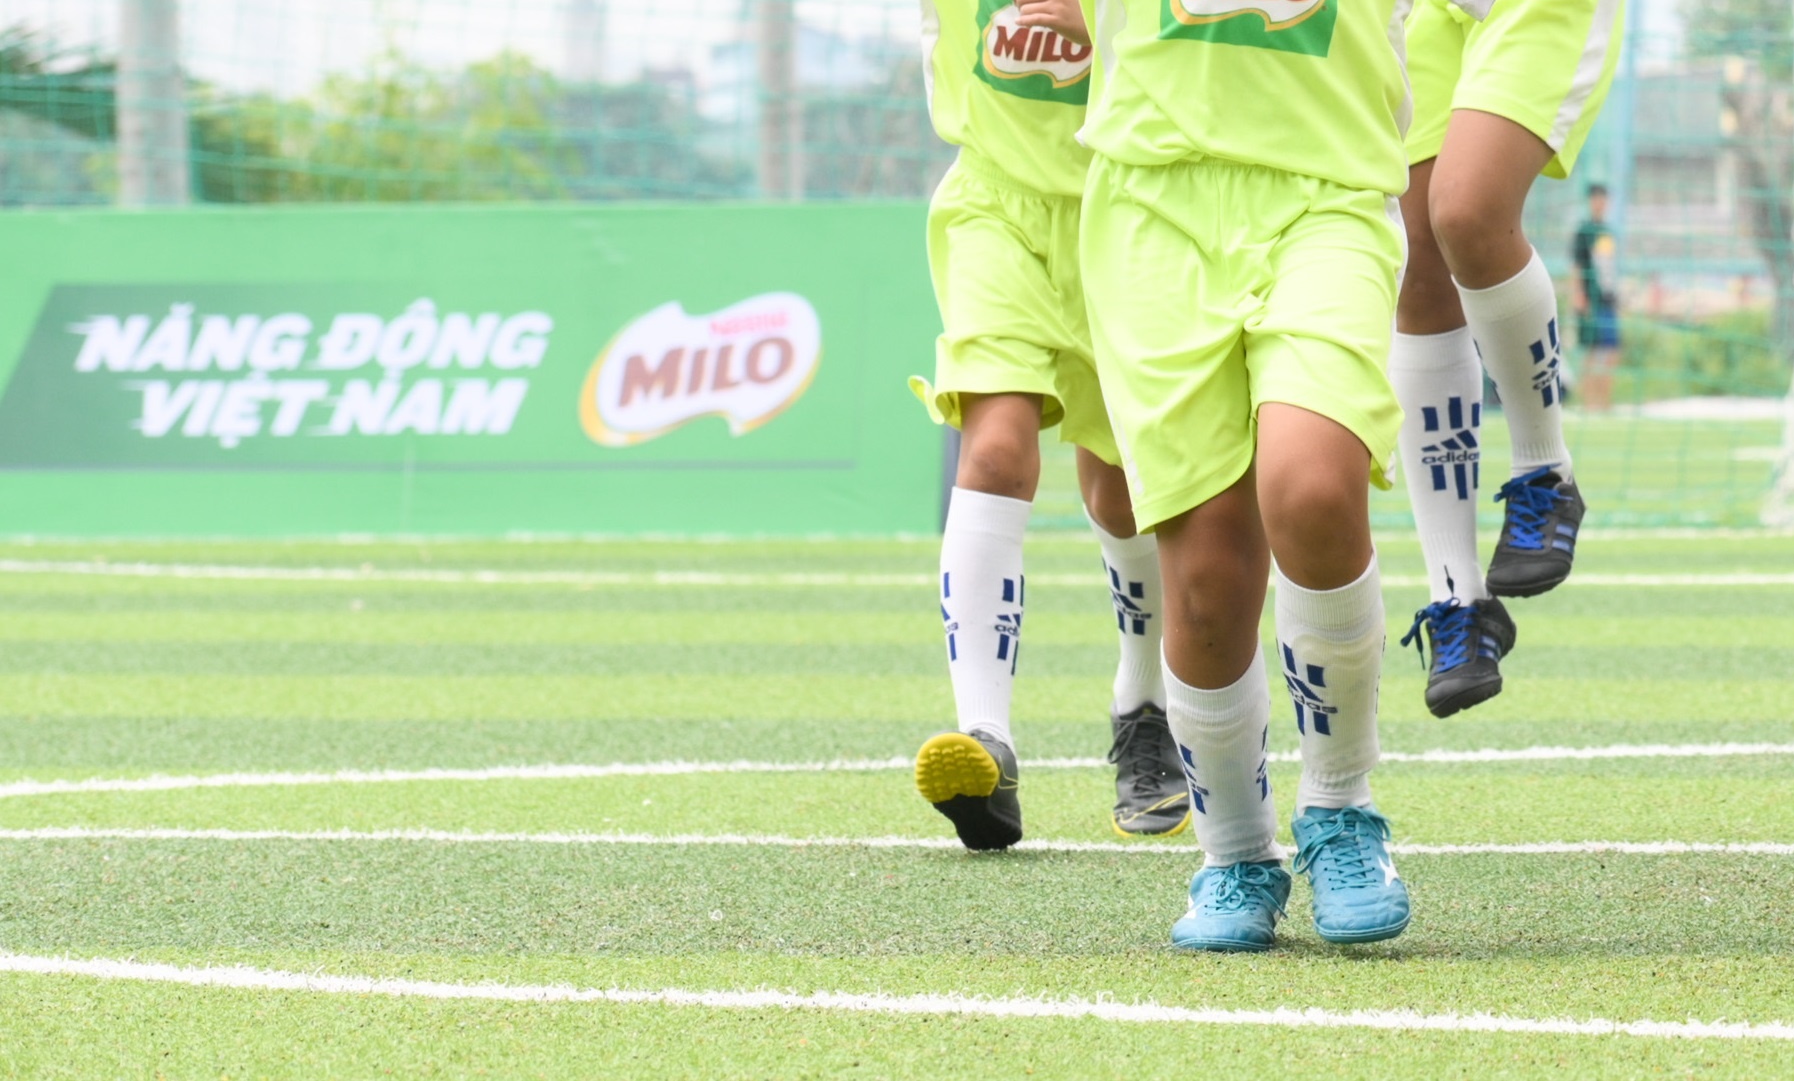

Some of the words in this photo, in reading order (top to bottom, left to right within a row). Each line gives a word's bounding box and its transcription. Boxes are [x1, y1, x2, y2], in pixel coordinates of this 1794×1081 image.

[993, 25, 1093, 63] MILO
[74, 300, 313, 372] NĂNG
[314, 296, 554, 382] ĐỘNG
[617, 336, 796, 408] MILO
[130, 369, 331, 449] VIỆT
[326, 376, 528, 436] NAM
[1422, 450, 1480, 464] adida
